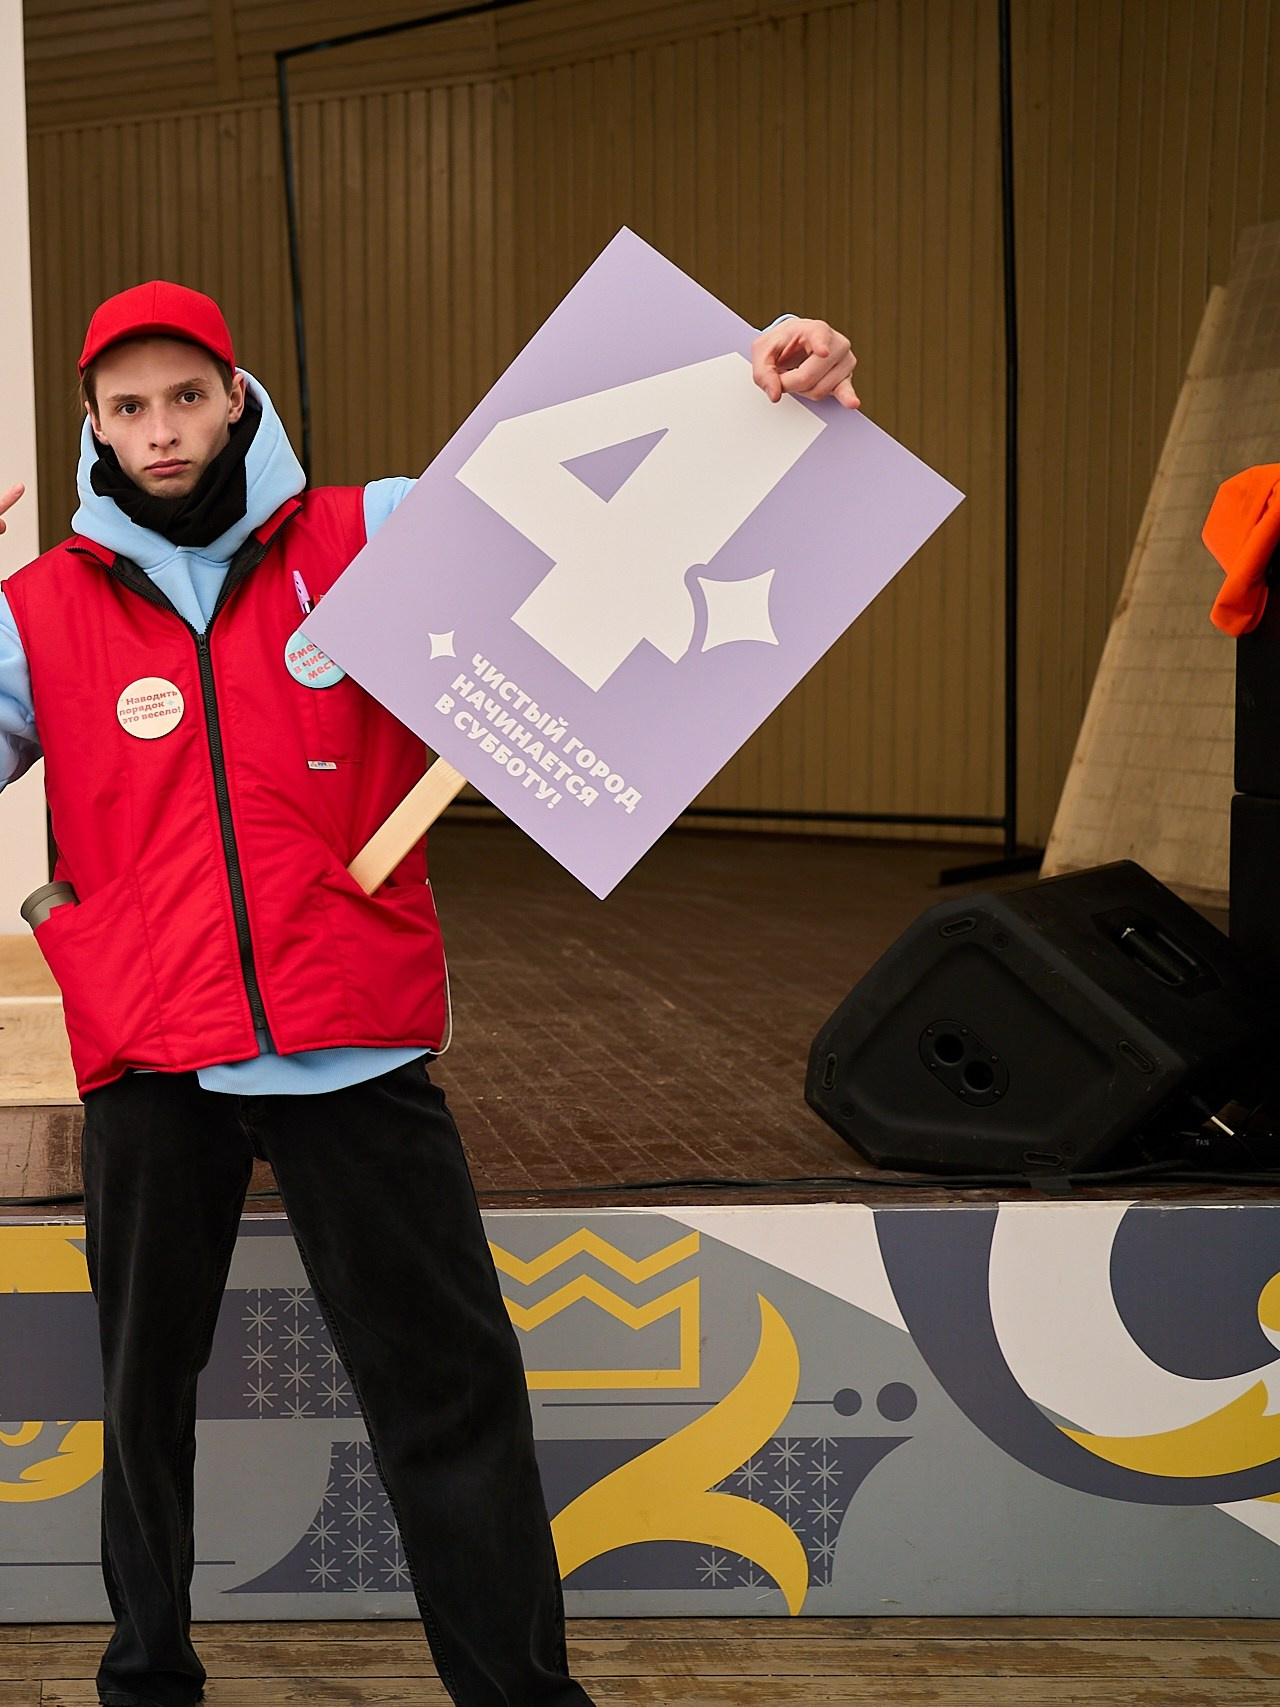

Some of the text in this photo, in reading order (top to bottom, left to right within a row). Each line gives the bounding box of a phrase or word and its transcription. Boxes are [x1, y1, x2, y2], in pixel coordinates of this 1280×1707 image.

[455, 352, 827, 692] 4
[288, 644, 318, 663] Вме
[302, 651, 326, 668] чис
[307, 659, 336, 680] мест
[126, 690, 178, 705] Наводить
[119, 701, 165, 716] порядок
[122, 706, 182, 725] это весело!
[450, 673, 600, 807] НАЧИНАЕТСЯ
[472, 653, 643, 815] ЧИСТЫЙ ГОРОД
[434, 693, 563, 810] В СУББОТУ!
